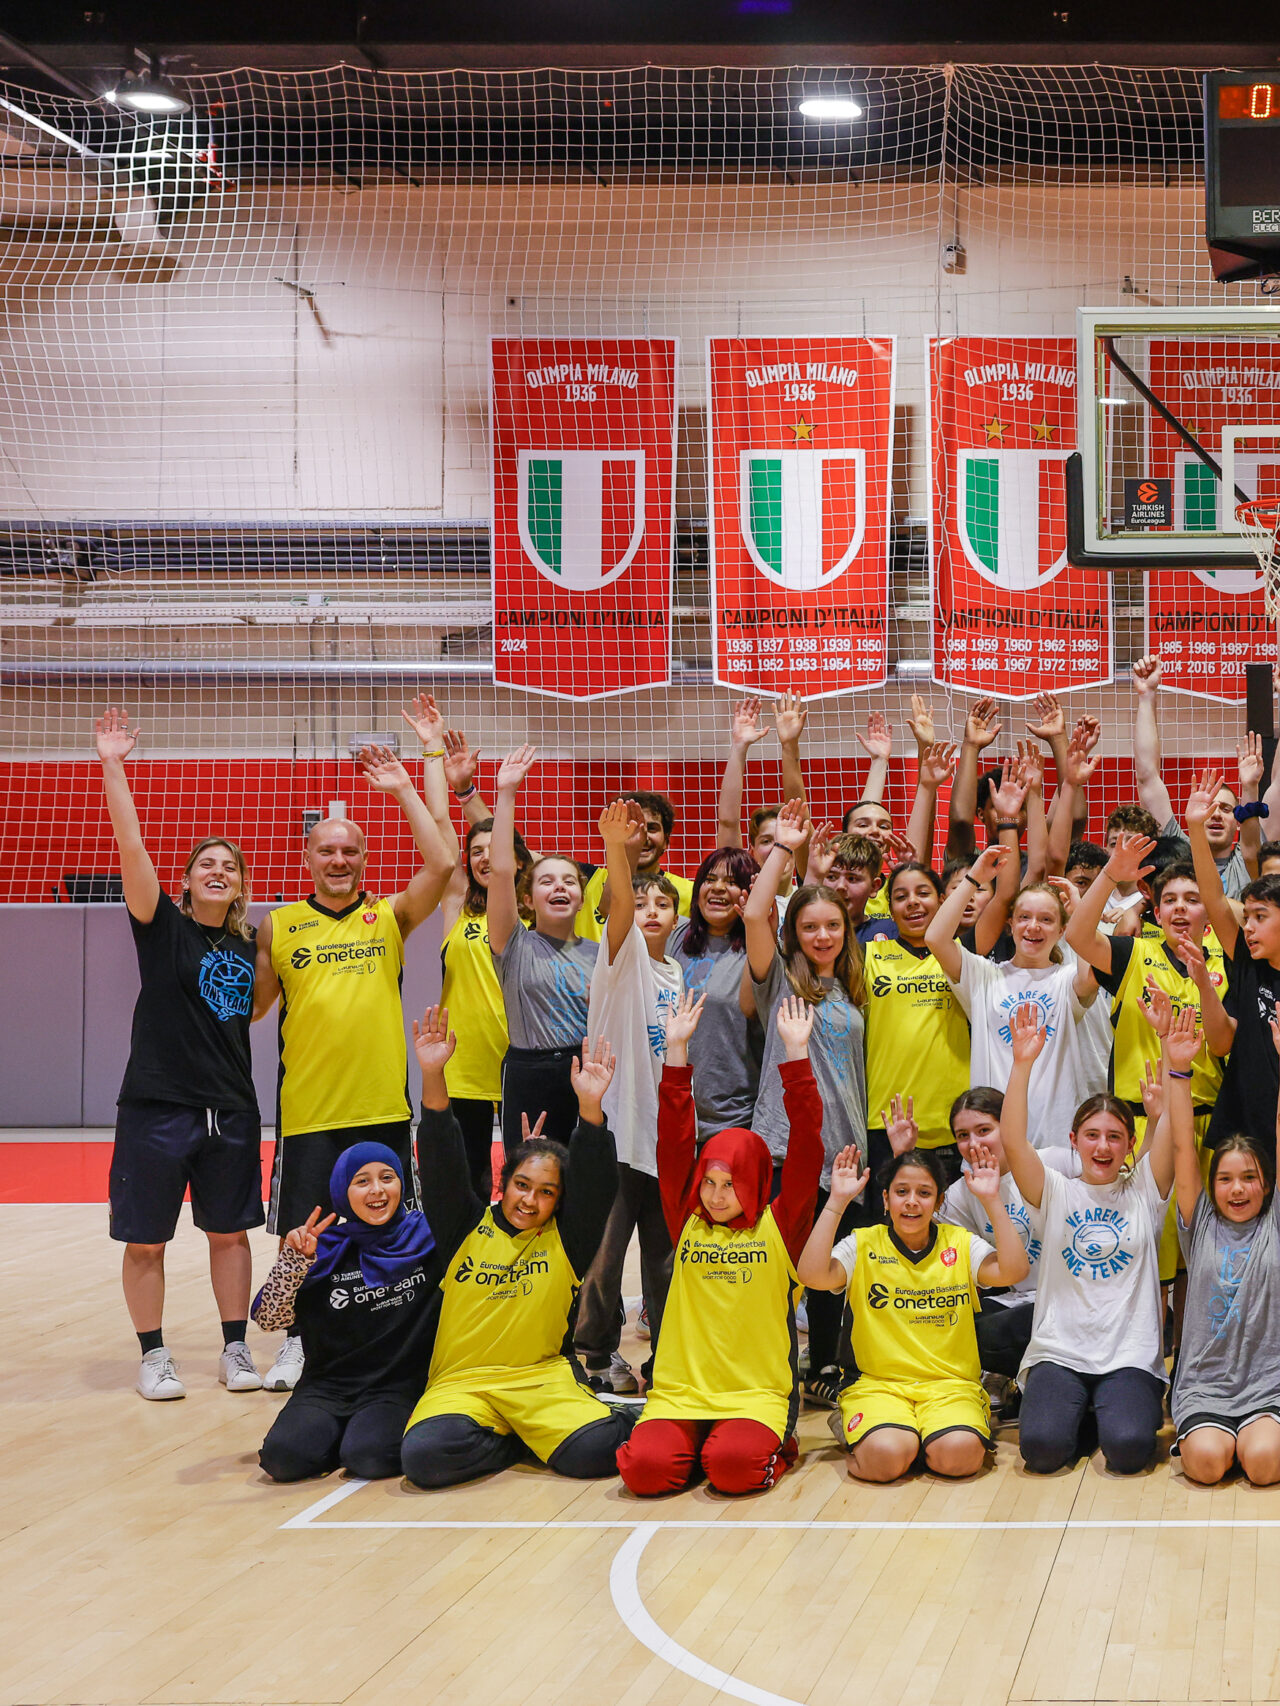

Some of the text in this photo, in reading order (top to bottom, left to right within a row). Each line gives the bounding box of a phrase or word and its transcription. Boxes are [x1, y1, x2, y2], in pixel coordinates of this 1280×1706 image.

[1251, 84, 1272, 118] 0
[526, 363, 639, 389] OLIMPIA MILANO
[745, 362, 858, 388] OLIMPIA MILANO
[963, 361, 1076, 389] OLIMPIA MILANO
[1183, 366, 1241, 391] OLIMPIA
[564, 384, 597, 403] 1936
[783, 383, 817, 402] 1936
[1001, 383, 1034, 401] 1936
[1220, 388, 1253, 405] 1936
[498, 610, 587, 629] CAMPIONI
[722, 608, 884, 630] CAMPIONI D'ITALIA
[1030, 609, 1104, 629] D'ITALIA
[1155, 611, 1241, 632] CAMPIONI
[500, 639, 528, 652] 2024
[727, 638, 882, 653] 1936 1937 1938 1939 1950
[971, 638, 999, 652] 1959
[1004, 639, 1033, 652] 1960
[1037, 639, 1066, 652] 1962
[1071, 639, 1099, 652] 1963
[1158, 641, 1183, 655] 1985
[1188, 641, 1216, 655] 1986
[1221, 643, 1250, 656] 1987
[727, 658, 882, 672] 1951 1952 1953 1954 1957
[971, 658, 999, 671] 1966
[1004, 658, 1032, 671] 1967
[1037, 658, 1066, 671] 1972
[1071, 658, 1099, 671] 1982
[1160, 661, 1183, 674] 2014
[1188, 661, 1216, 674] 2016
[316, 942, 356, 951] Euroleague
[316, 945, 386, 964] oneteam
[896, 980, 953, 994] onetea
[1000, 990, 1056, 1010] WE ARE ALL
[998, 1024, 1014, 1047] ON
[1017, 1206, 1031, 1225] ALL
[1085, 1207, 1112, 1223] ARE
[1111, 1210, 1129, 1233] ALL
[690, 1250, 768, 1264] oneteam
[1061, 1246, 1134, 1281] ONE TEAM
[893, 1292, 970, 1309] oneteam
[895, 1287, 936, 1297] Euroleague
